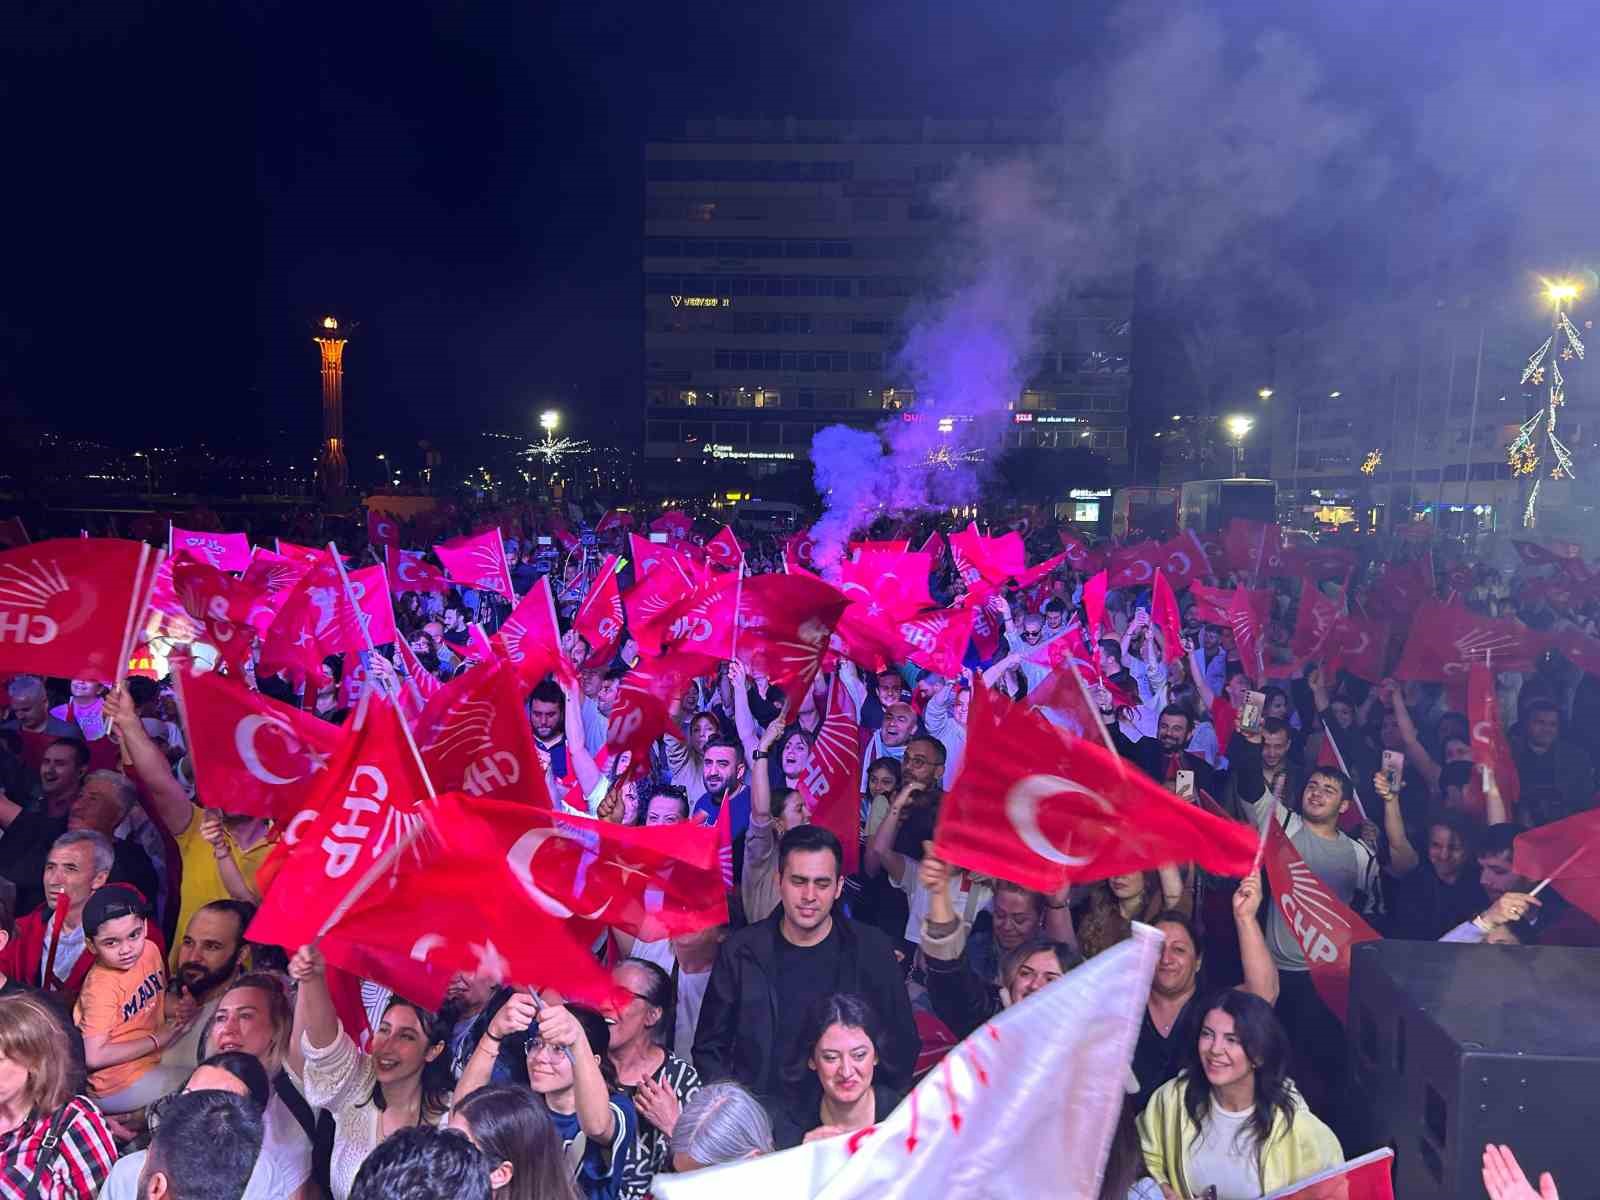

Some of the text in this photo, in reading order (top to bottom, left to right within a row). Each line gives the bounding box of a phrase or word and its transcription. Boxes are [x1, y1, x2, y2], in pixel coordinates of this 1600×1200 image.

[803, 752, 830, 797] HP
[321, 765, 389, 878] CHP
[1281, 893, 1339, 963] CHP
[123, 970, 163, 1022] MADR
